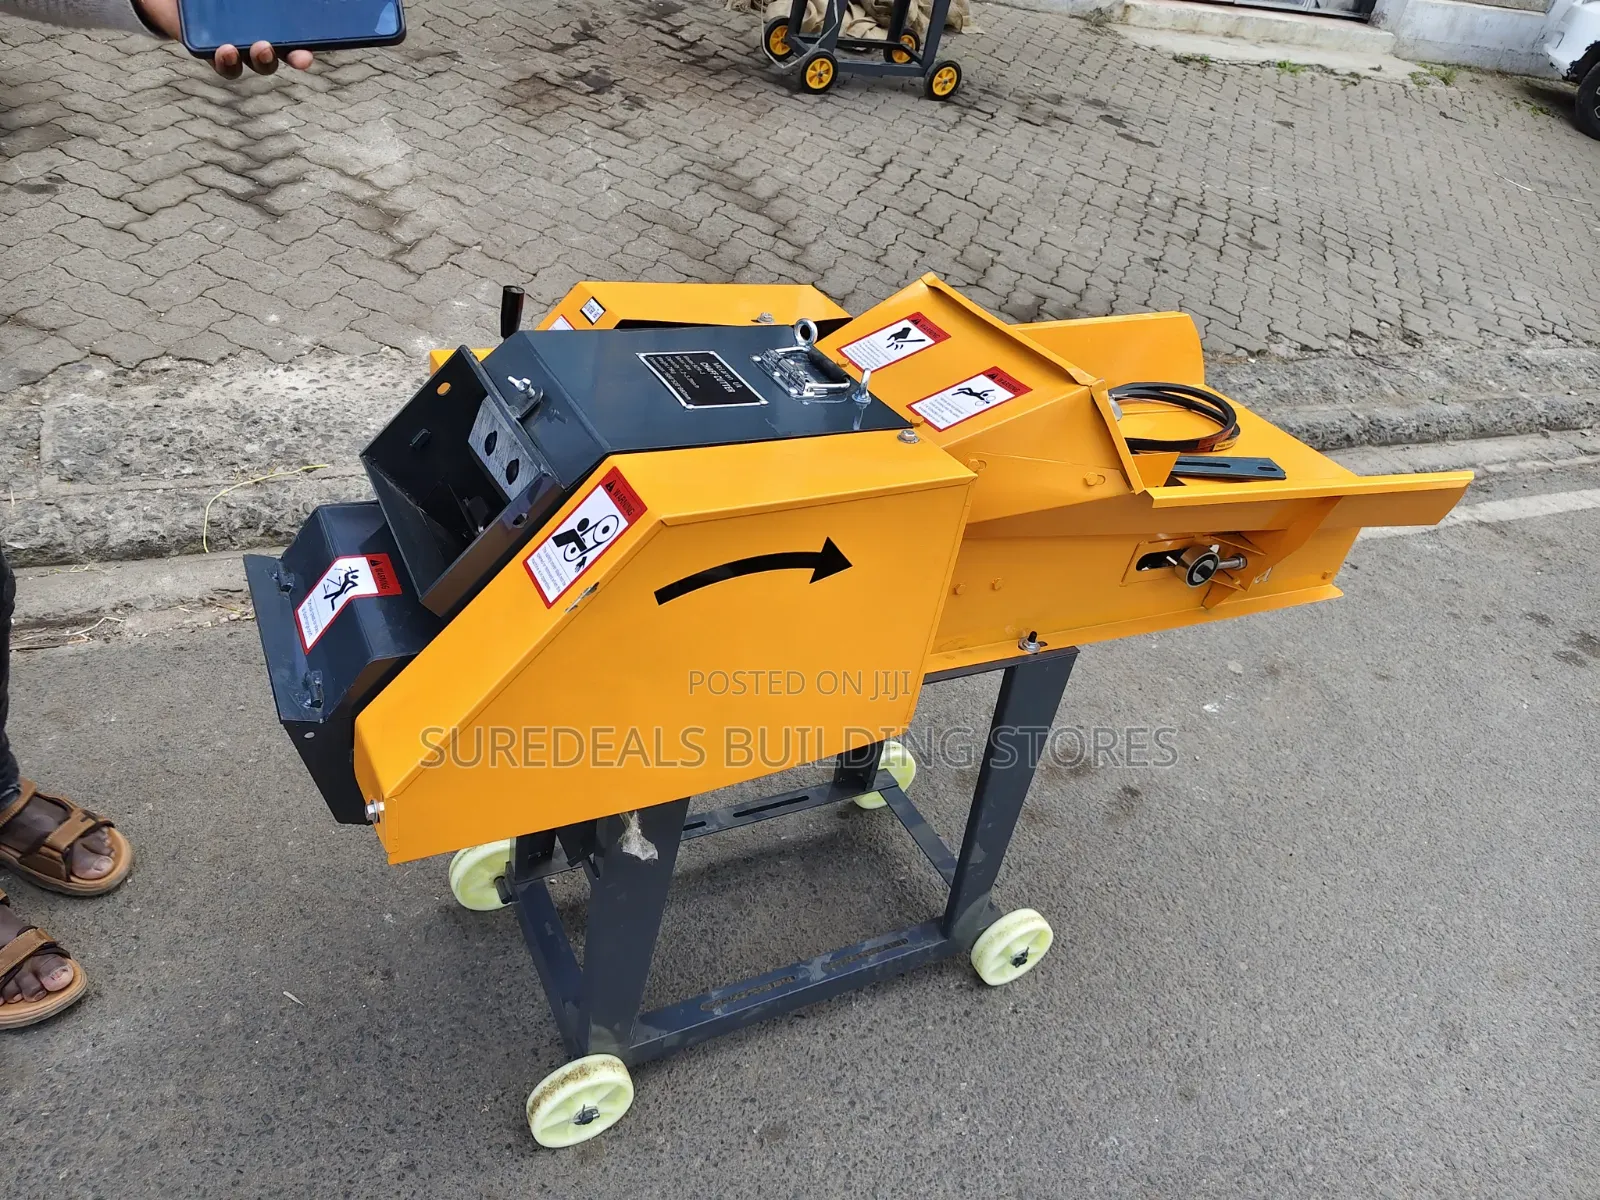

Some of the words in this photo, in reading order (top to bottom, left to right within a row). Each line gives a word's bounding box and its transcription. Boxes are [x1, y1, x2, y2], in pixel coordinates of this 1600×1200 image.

[700, 361, 719, 375] CHAFF
[714, 376, 736, 392] CUTTER
[996, 378, 1020, 393] WARNING
[613, 489, 636, 516] WARNING
[374, 568, 390, 590] WARNING
